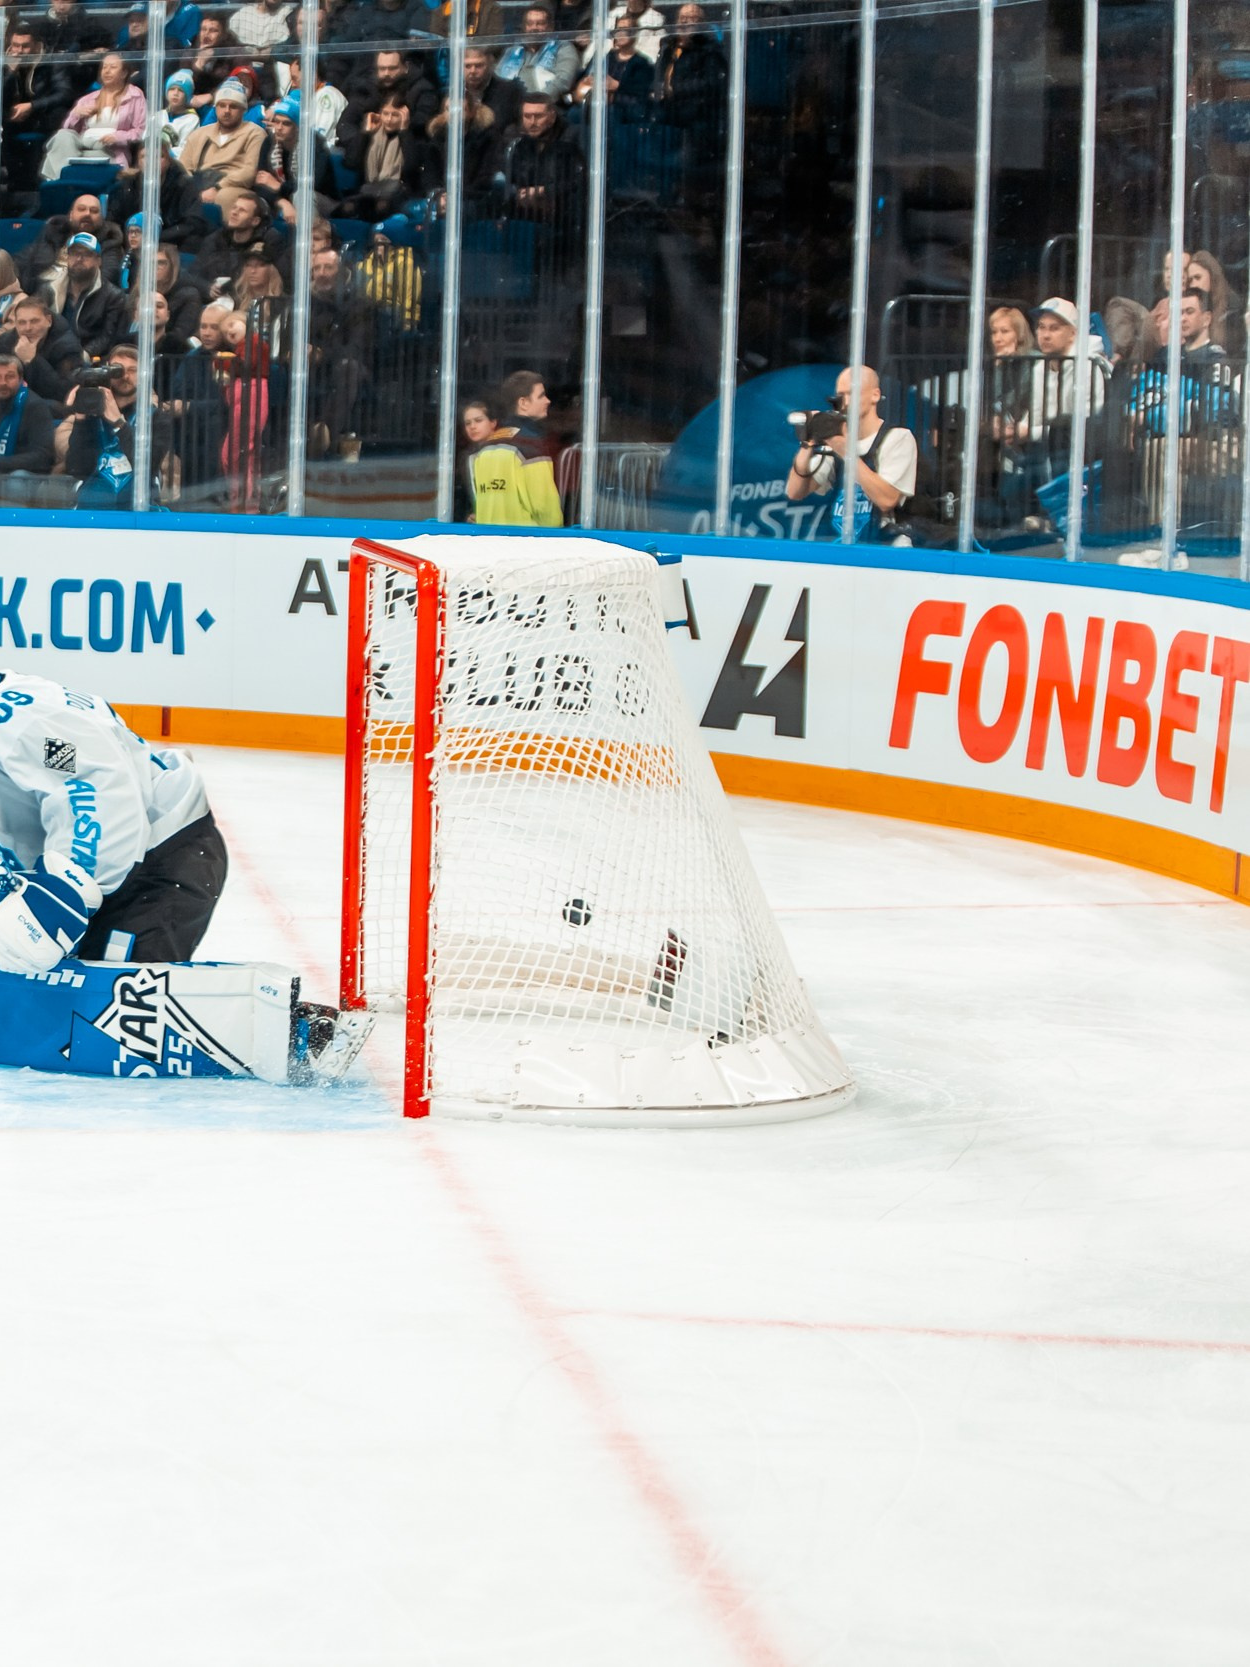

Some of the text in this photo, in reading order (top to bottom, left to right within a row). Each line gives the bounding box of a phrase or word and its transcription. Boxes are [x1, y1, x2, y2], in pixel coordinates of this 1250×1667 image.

[731, 480, 787, 501] FONB
[888, 599, 1250, 814] FONBET
[17, 914, 43, 940] CYBER
[167, 1035, 193, 1077] 25
